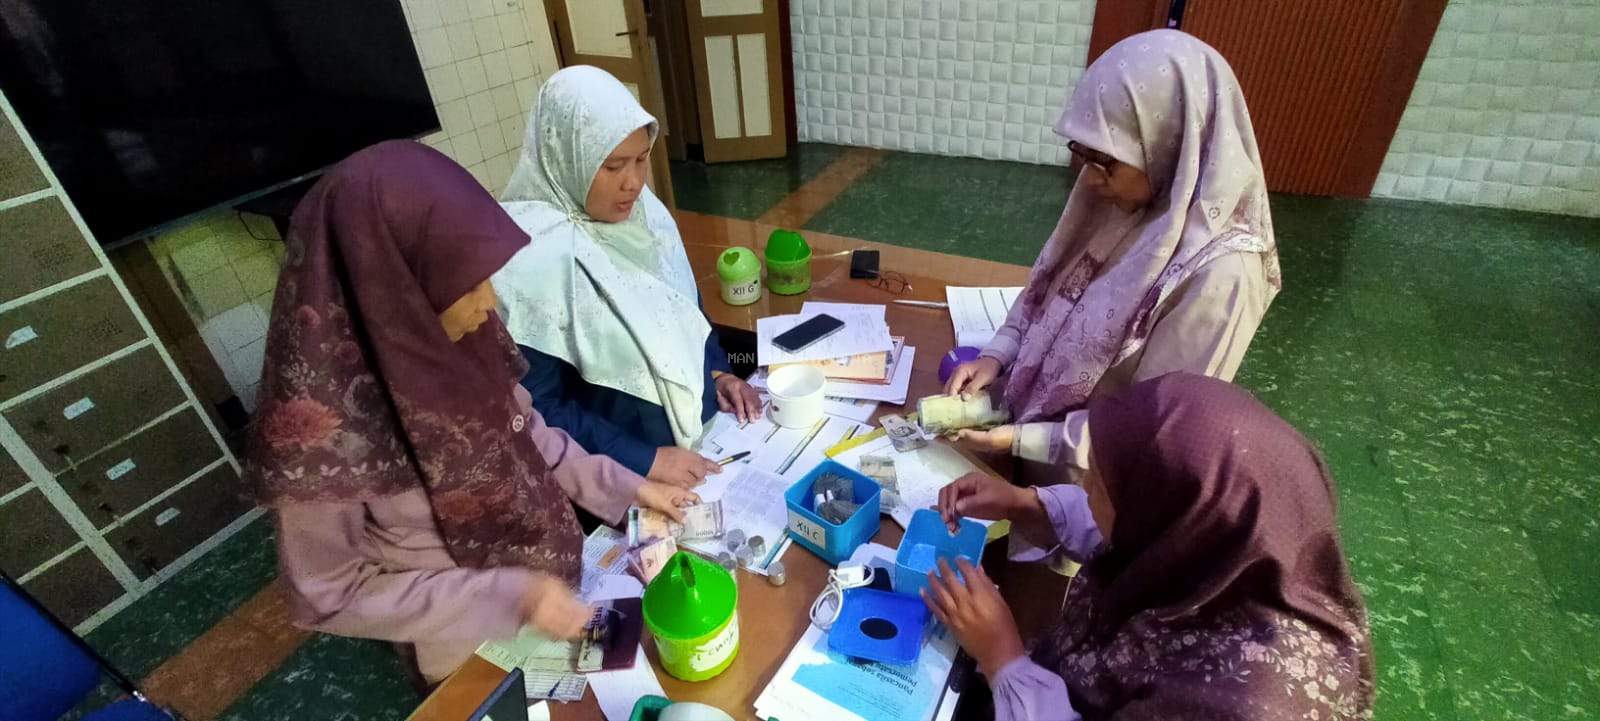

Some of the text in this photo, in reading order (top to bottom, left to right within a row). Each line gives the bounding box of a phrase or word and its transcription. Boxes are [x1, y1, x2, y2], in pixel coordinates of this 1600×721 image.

[732, 284, 754, 296] XII G
[876, 672, 914, 696] Pancasila
